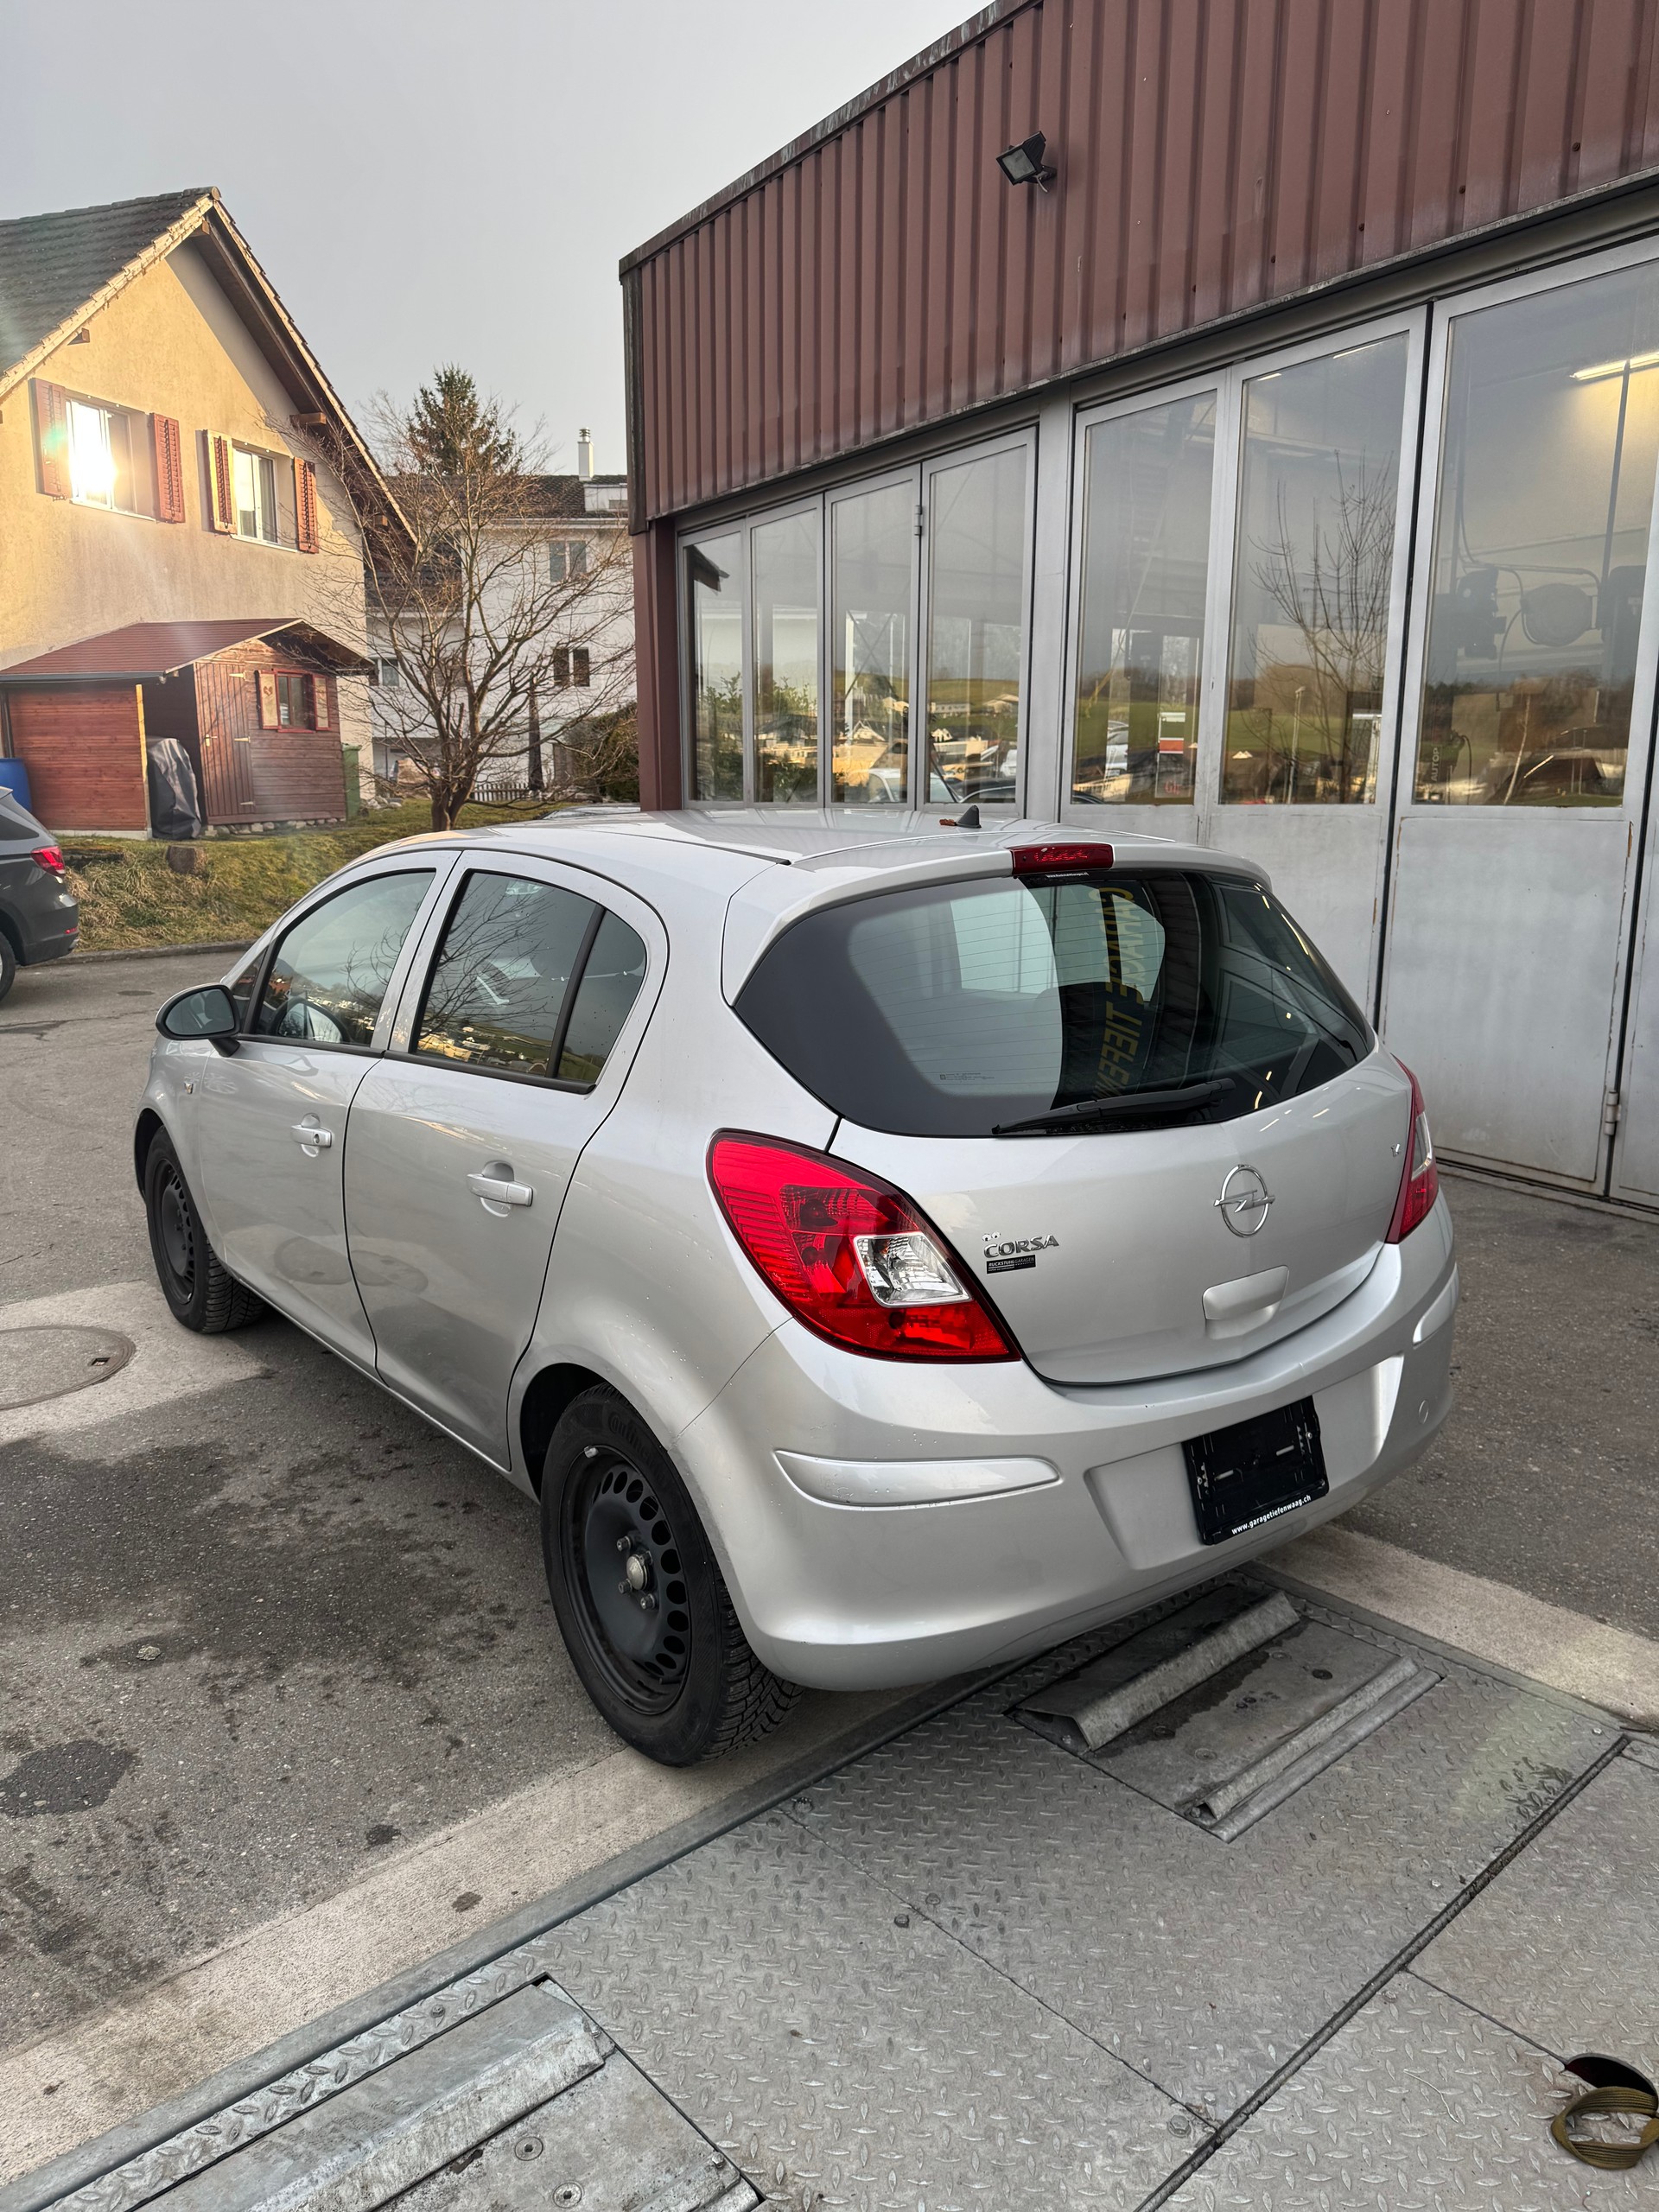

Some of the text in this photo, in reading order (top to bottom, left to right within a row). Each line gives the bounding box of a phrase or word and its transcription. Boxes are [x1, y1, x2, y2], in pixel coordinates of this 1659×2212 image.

[1430, 747, 1440, 782] AUTOP
[983, 1234, 1059, 1258] CORSA
[1231, 1494, 1312, 1535] www.garagetiefenwaag.ch
